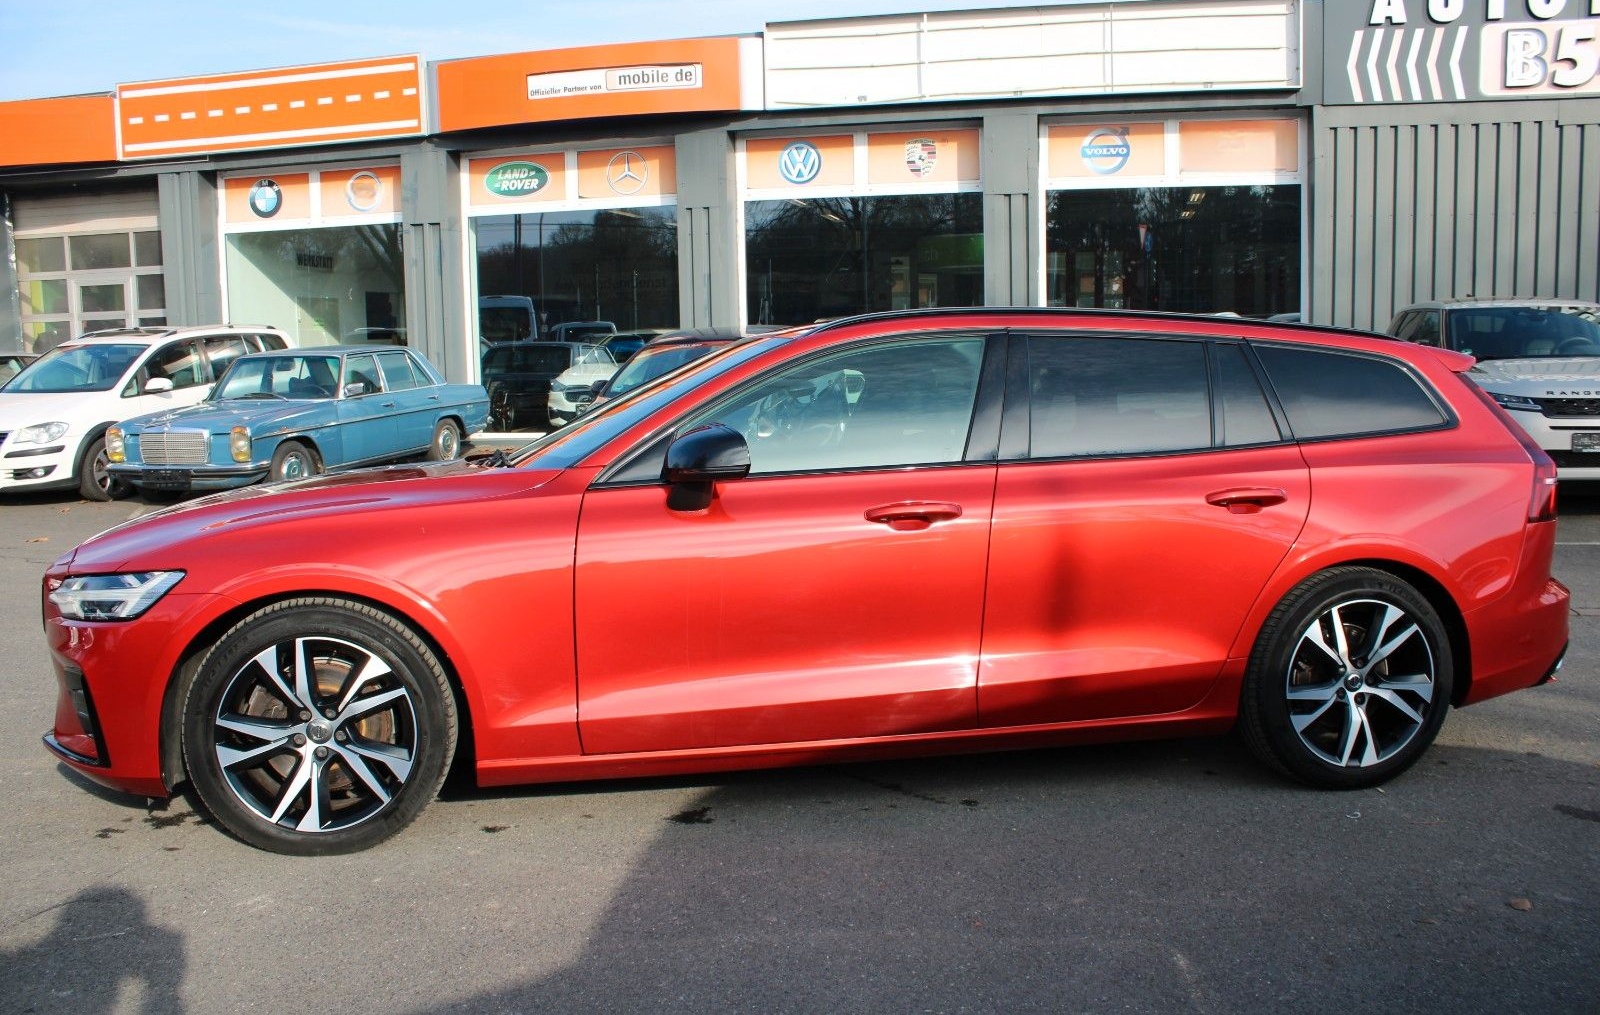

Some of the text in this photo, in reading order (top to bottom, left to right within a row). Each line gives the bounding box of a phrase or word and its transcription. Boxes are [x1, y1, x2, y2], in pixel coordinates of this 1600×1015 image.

[563, 85, 588, 93] Partner
[1086, 147, 1128, 155] VOLVO
[497, 168, 529, 180] LAND
[500, 178, 540, 191] ROVER
